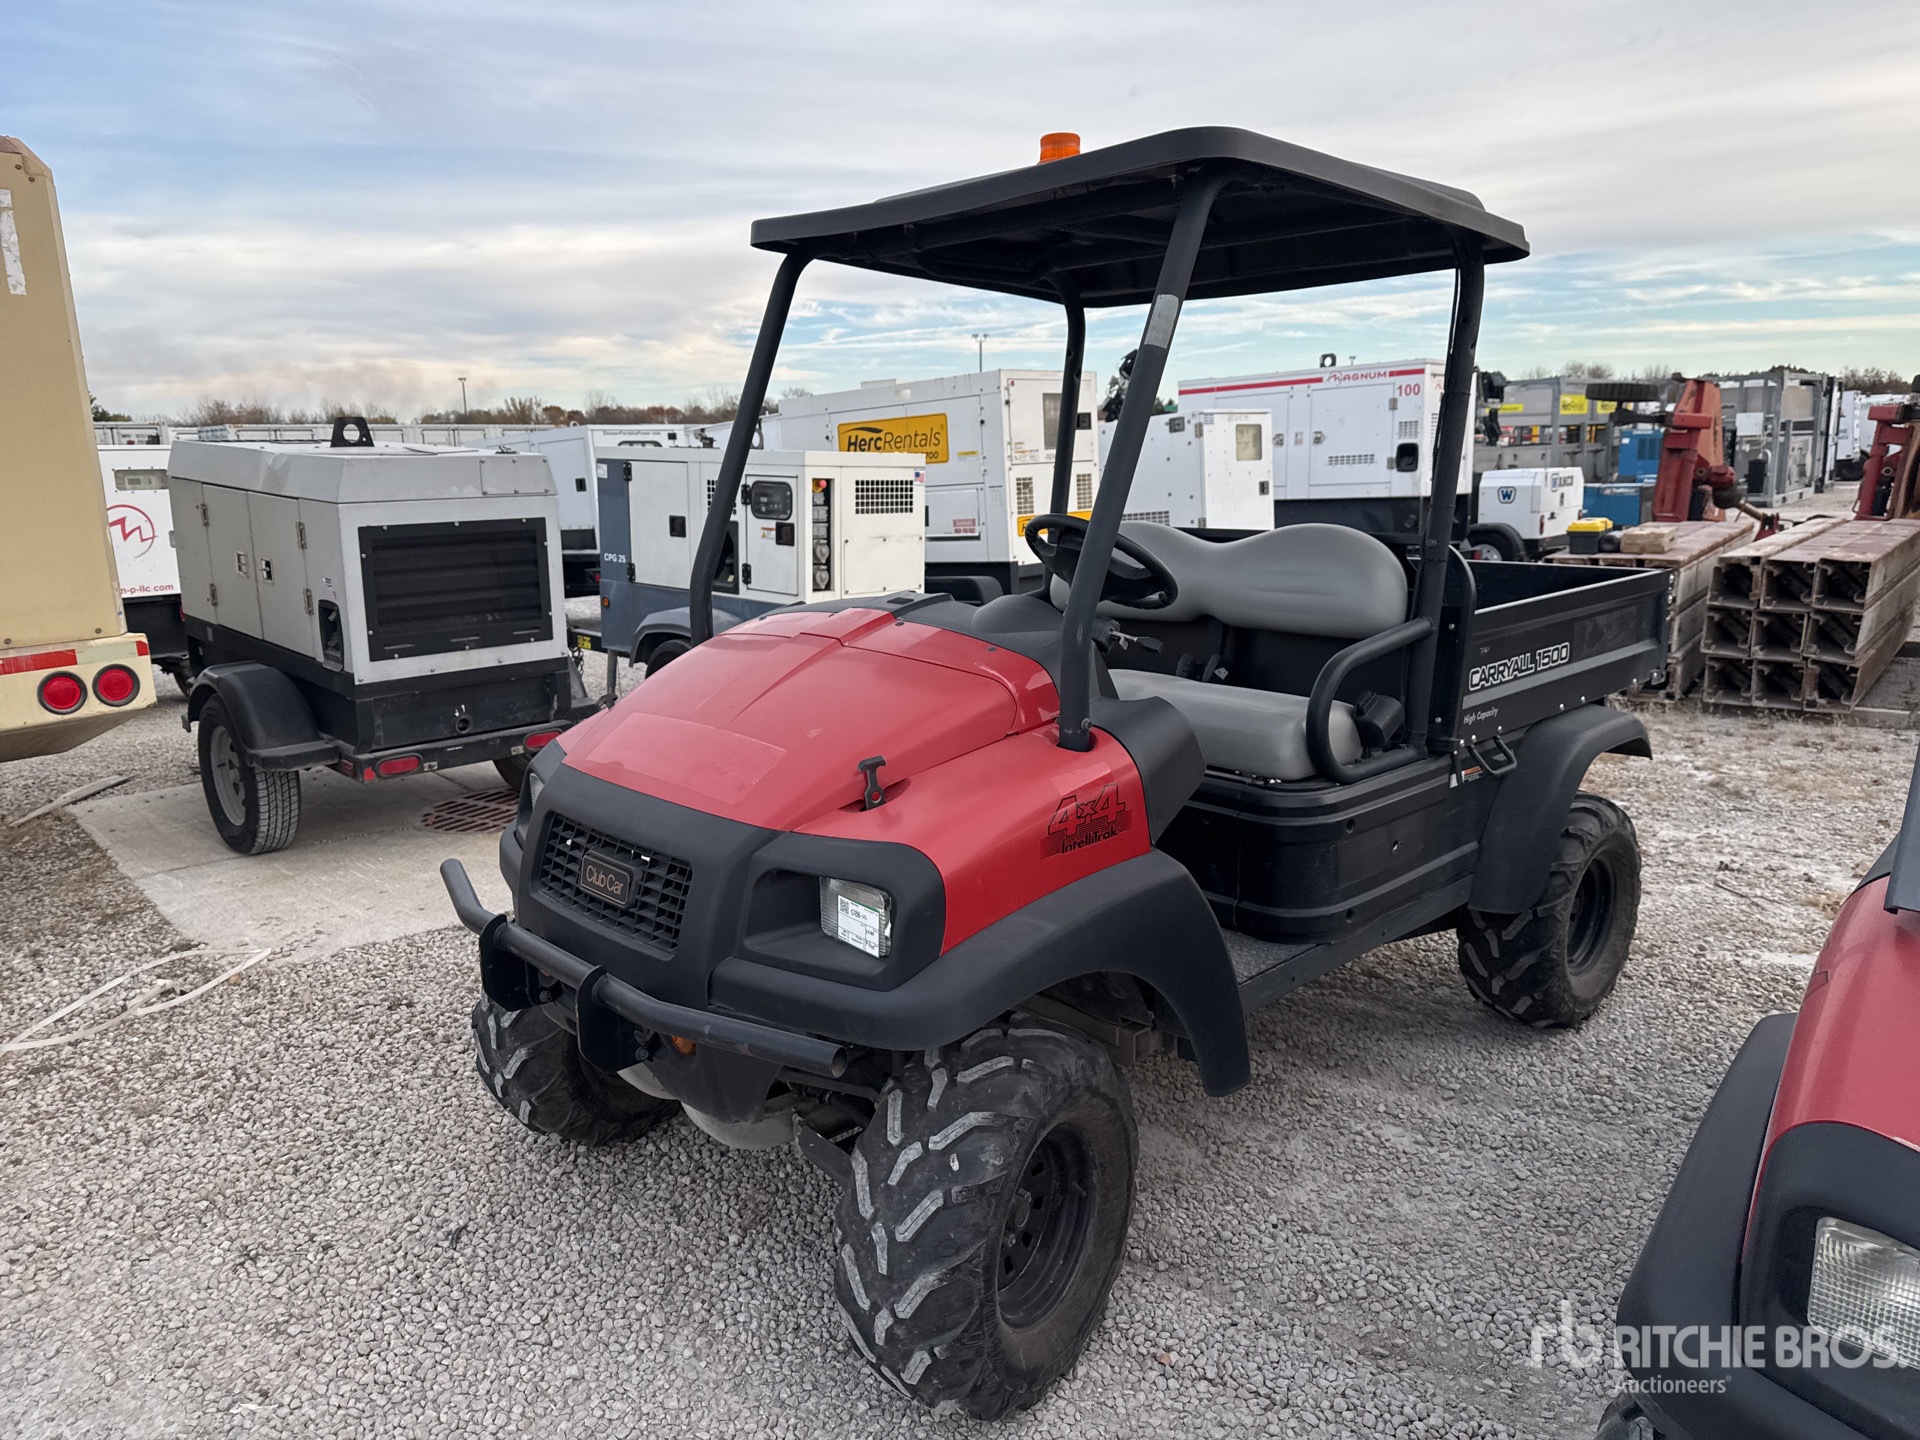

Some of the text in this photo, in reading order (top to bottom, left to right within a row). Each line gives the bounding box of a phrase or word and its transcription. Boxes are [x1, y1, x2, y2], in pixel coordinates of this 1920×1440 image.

[1397, 383, 1421, 397] 100
[847, 427, 942, 452] HercRentals
[1501, 489, 1513, 500] W
[604, 552, 626, 563] CPG 25
[1469, 641, 1570, 691] CARRYALL 1500
[1463, 706, 1499, 725] High Capacity
[1048, 782, 1126, 837] 4x4
[1061, 826, 1119, 854] IntelliTrak
[586, 865, 624, 895] Club Car
